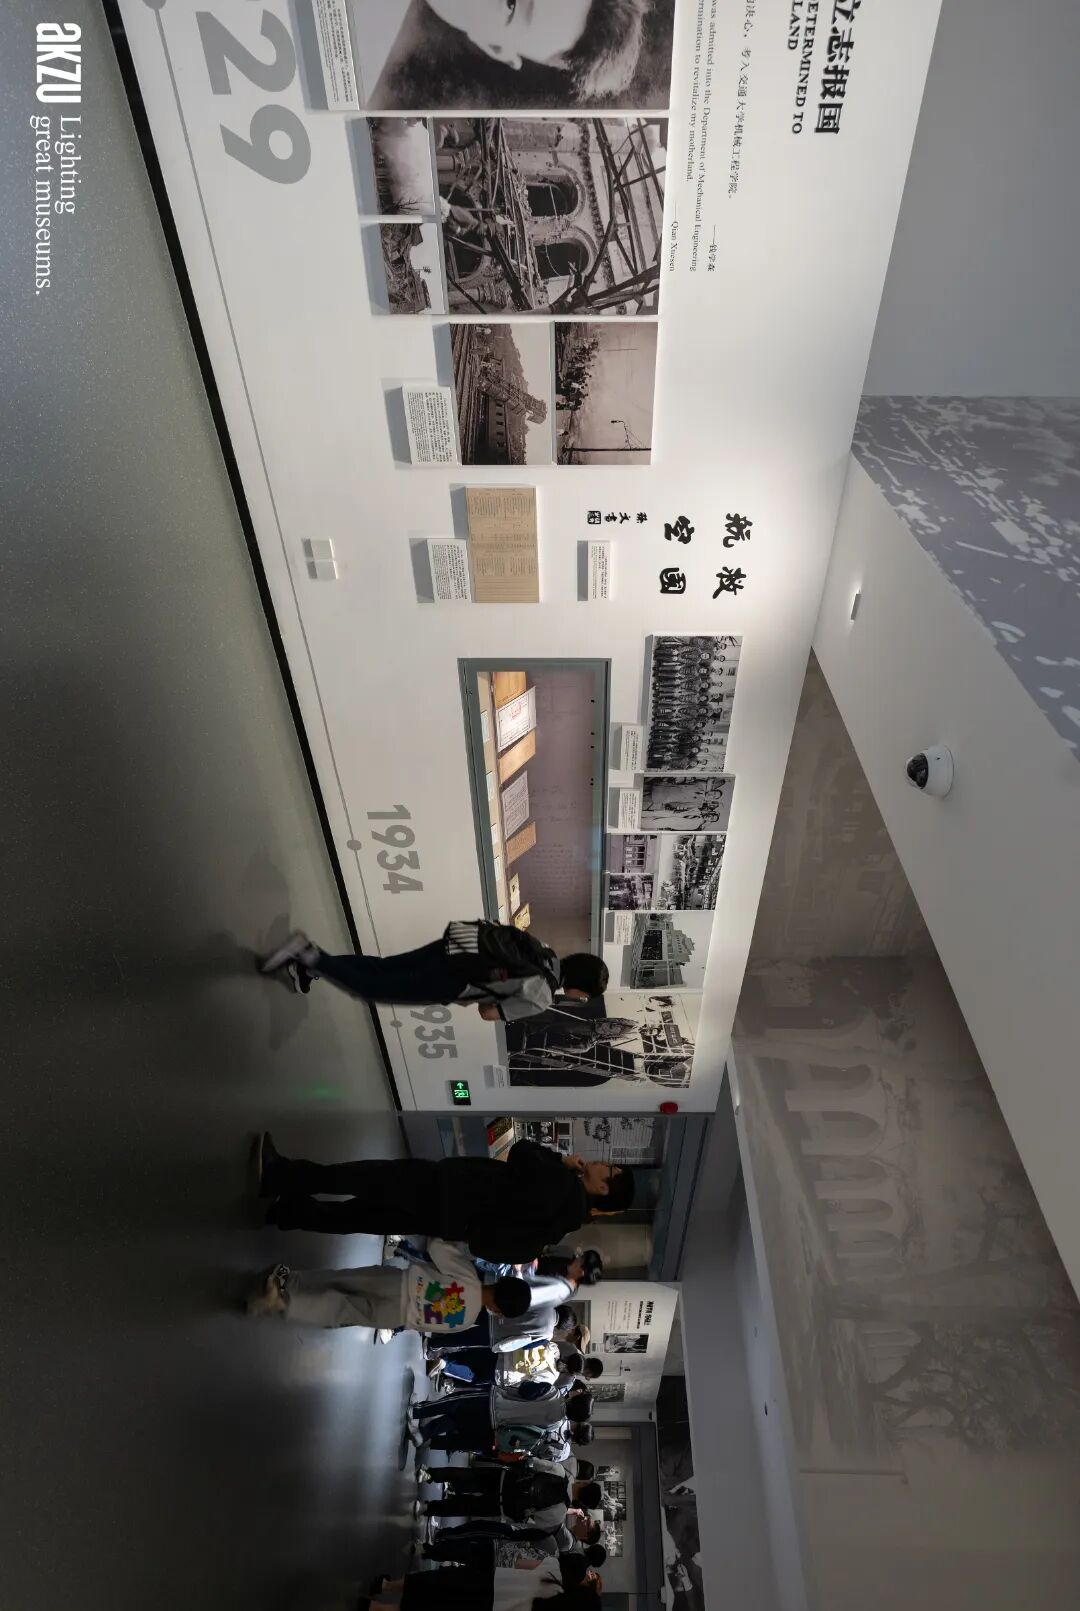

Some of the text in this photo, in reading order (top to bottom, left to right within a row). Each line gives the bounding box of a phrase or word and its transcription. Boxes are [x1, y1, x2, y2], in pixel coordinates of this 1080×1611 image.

[694, 55, 702, 64] to
[707, 22, 717, 65] admitted
[791, 0, 819, 135] ETERMINED TO
[814, 0, 861, 134] 立志报国
[195, 0, 312, 185] 29
[691, 67, 701, 111] revitalize
[703, 90, 712, 104] the
[705, 68, 714, 87] into
[689, 113, 697, 128] my
[700, 107, 711, 160] Department
[686, 130, 696, 182] motherland.
[698, 162, 706, 172] of
[694, 174, 705, 222] Mechanical
[669, 243, 678, 272] Xuesen
[690, 224, 702, 272] Engineering
[366, 804, 424, 894] 1934
[409, 1004, 458, 1059] 935
